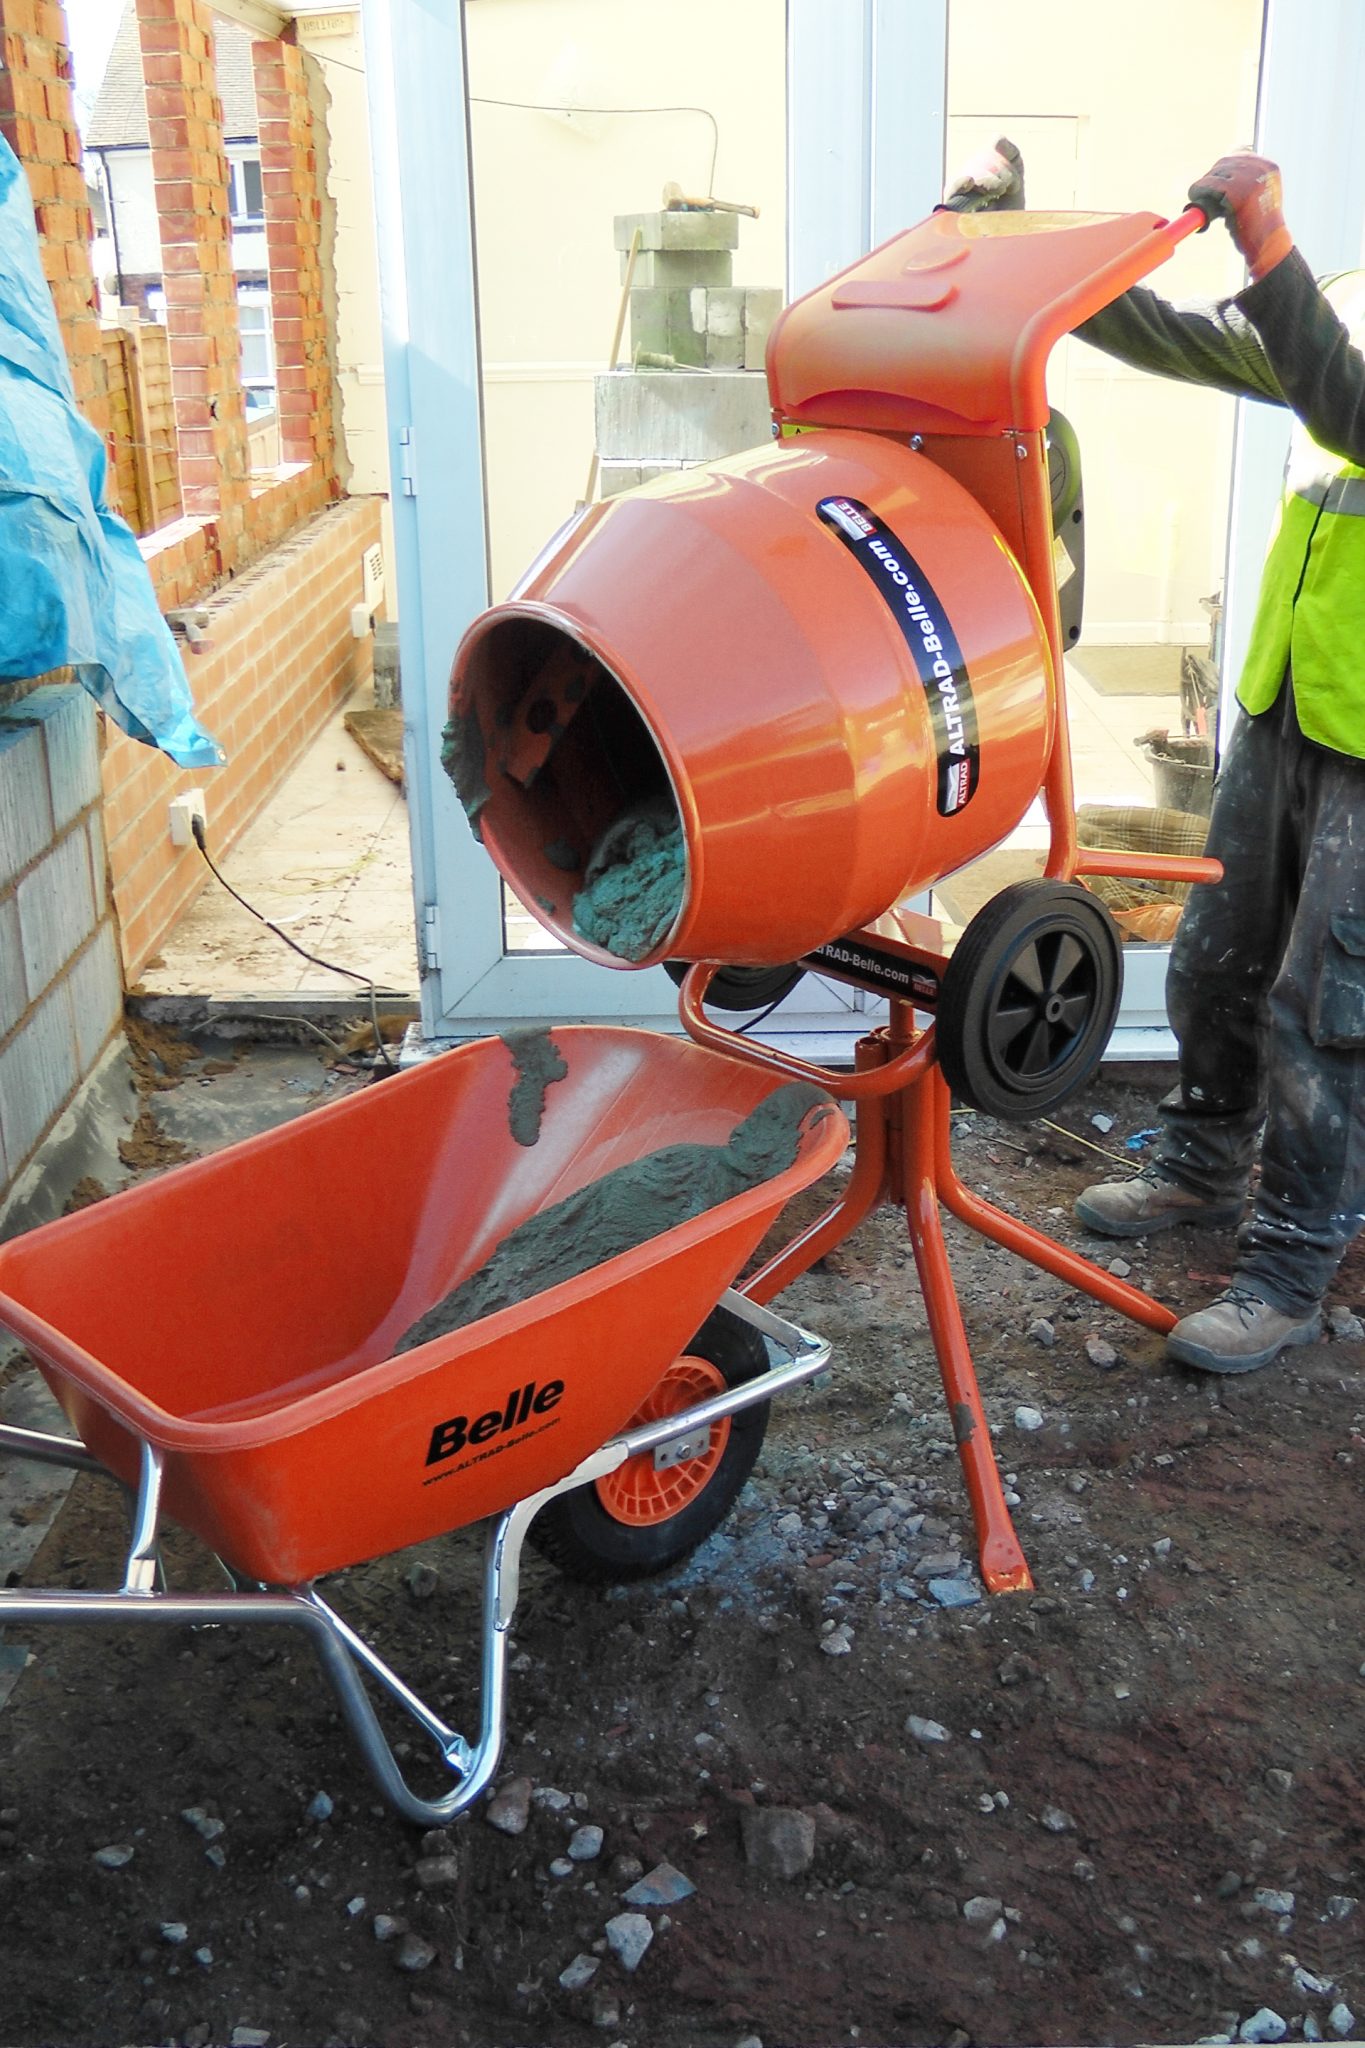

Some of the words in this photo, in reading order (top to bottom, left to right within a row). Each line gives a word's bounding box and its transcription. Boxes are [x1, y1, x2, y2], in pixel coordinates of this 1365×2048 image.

[838, 501, 874, 533] BELLE
[868, 540, 965, 756] ALTRAD-Belle.com
[958, 761, 969, 805] ALTRAD
[423, 1416, 561, 1487] www.ALTRAD-Belle.com
[425, 1379, 565, 1467] Belle
